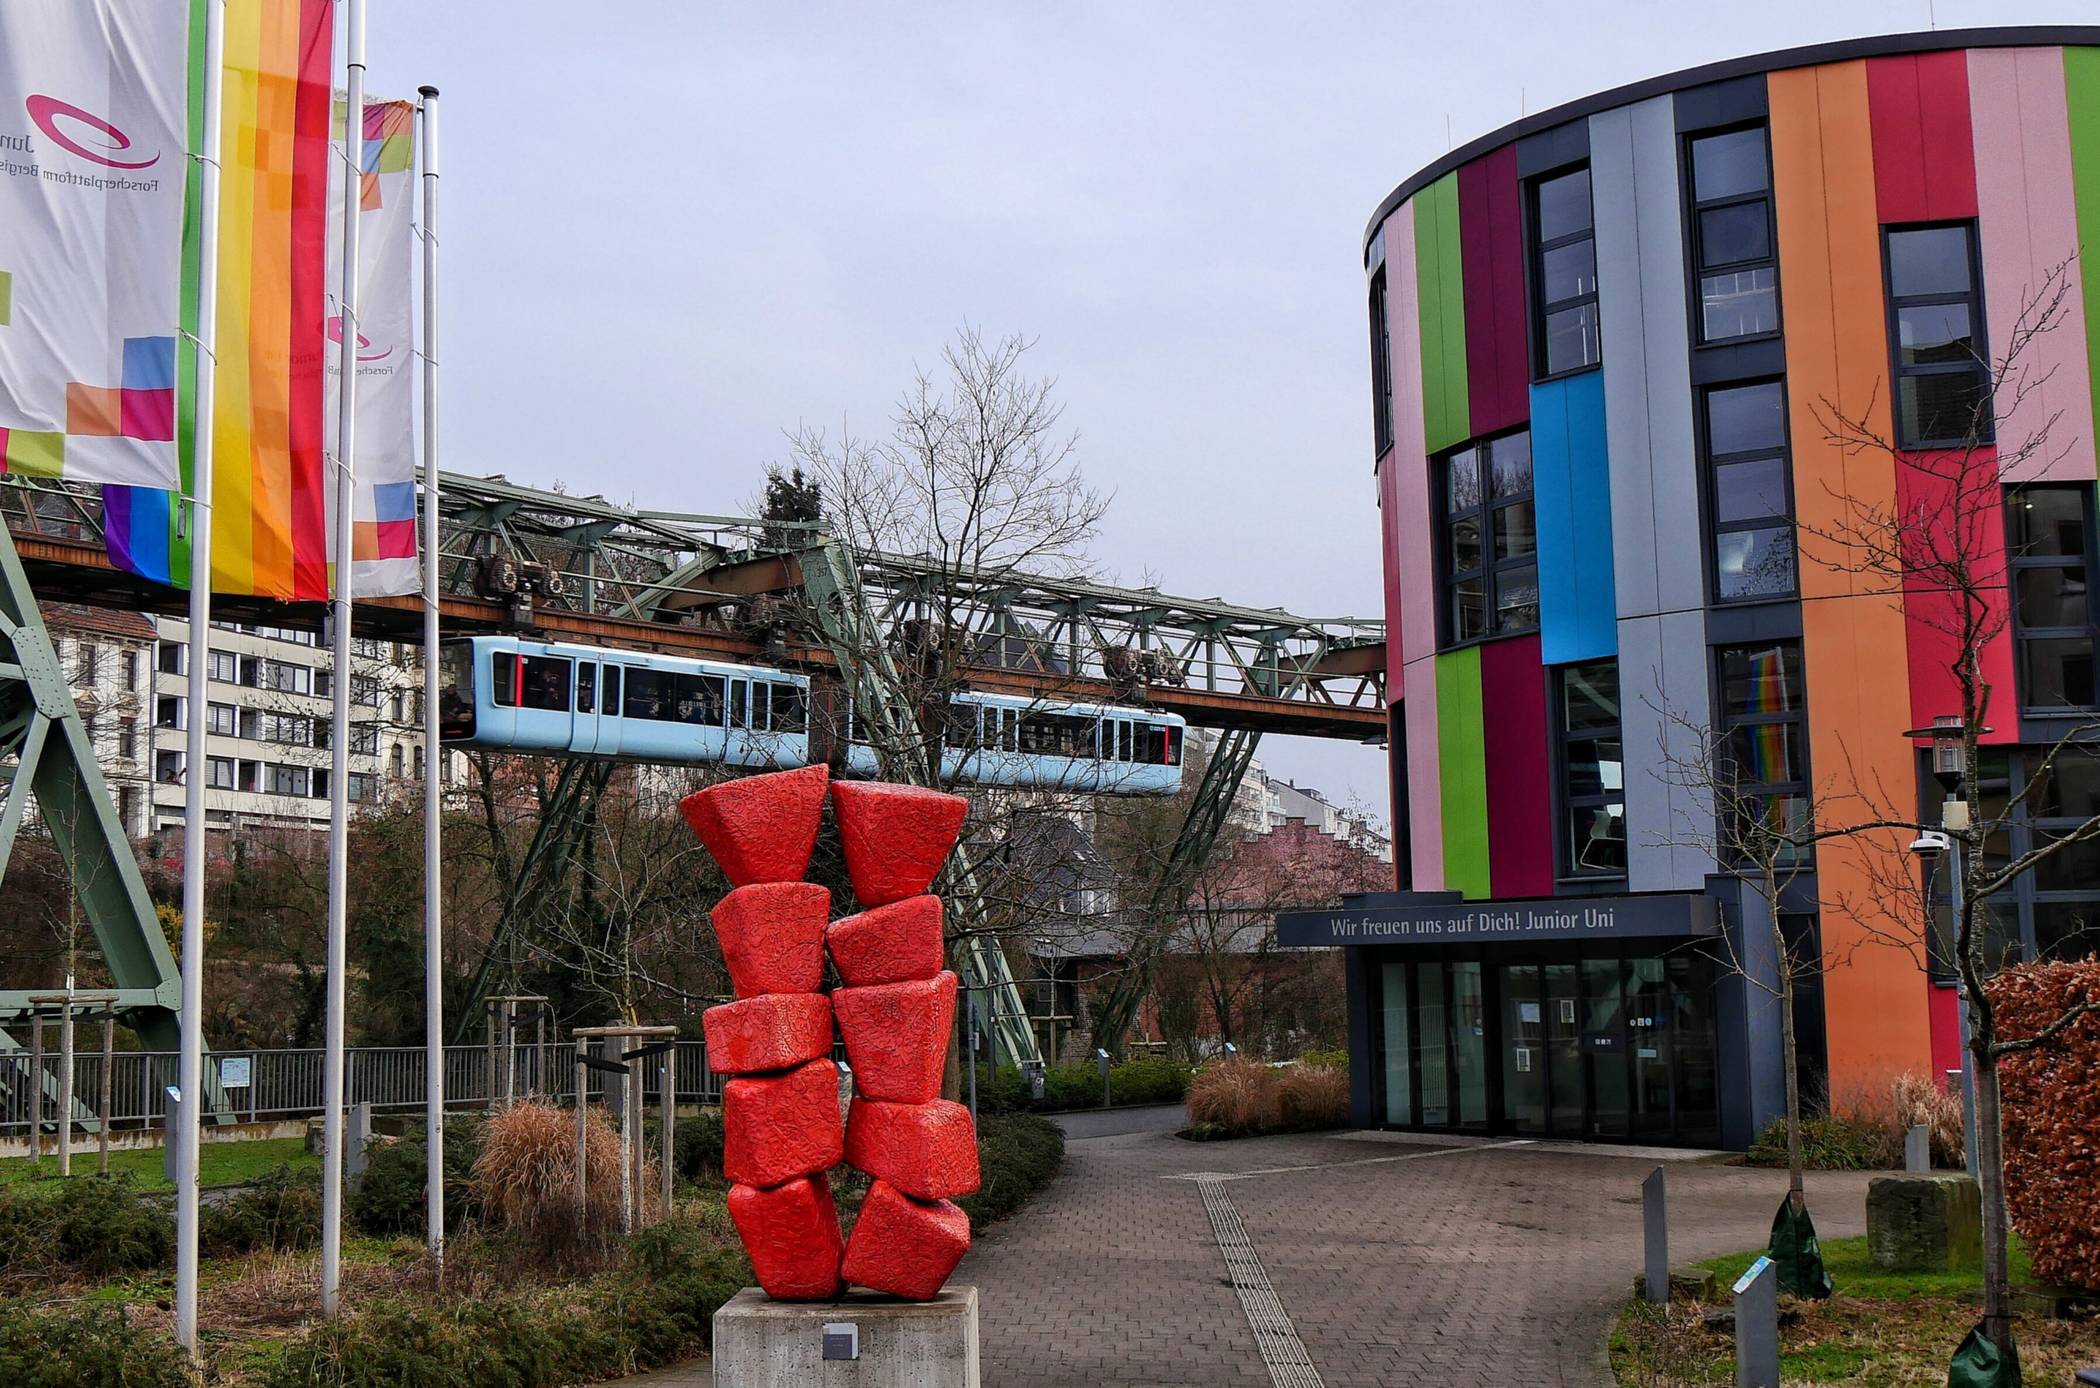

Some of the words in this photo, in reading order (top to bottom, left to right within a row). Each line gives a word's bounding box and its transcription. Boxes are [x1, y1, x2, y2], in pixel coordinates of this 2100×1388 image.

[1331, 918, 1357, 936] Wir
[1361, 917, 1410, 935] freuen
[1416, 919, 1442, 934] uns
[1447, 914, 1474, 933] auf
[1479, 912, 1520, 932] Dich!
[1525, 910, 1578, 930] Junior
[1585, 908, 1614, 928] Uni
